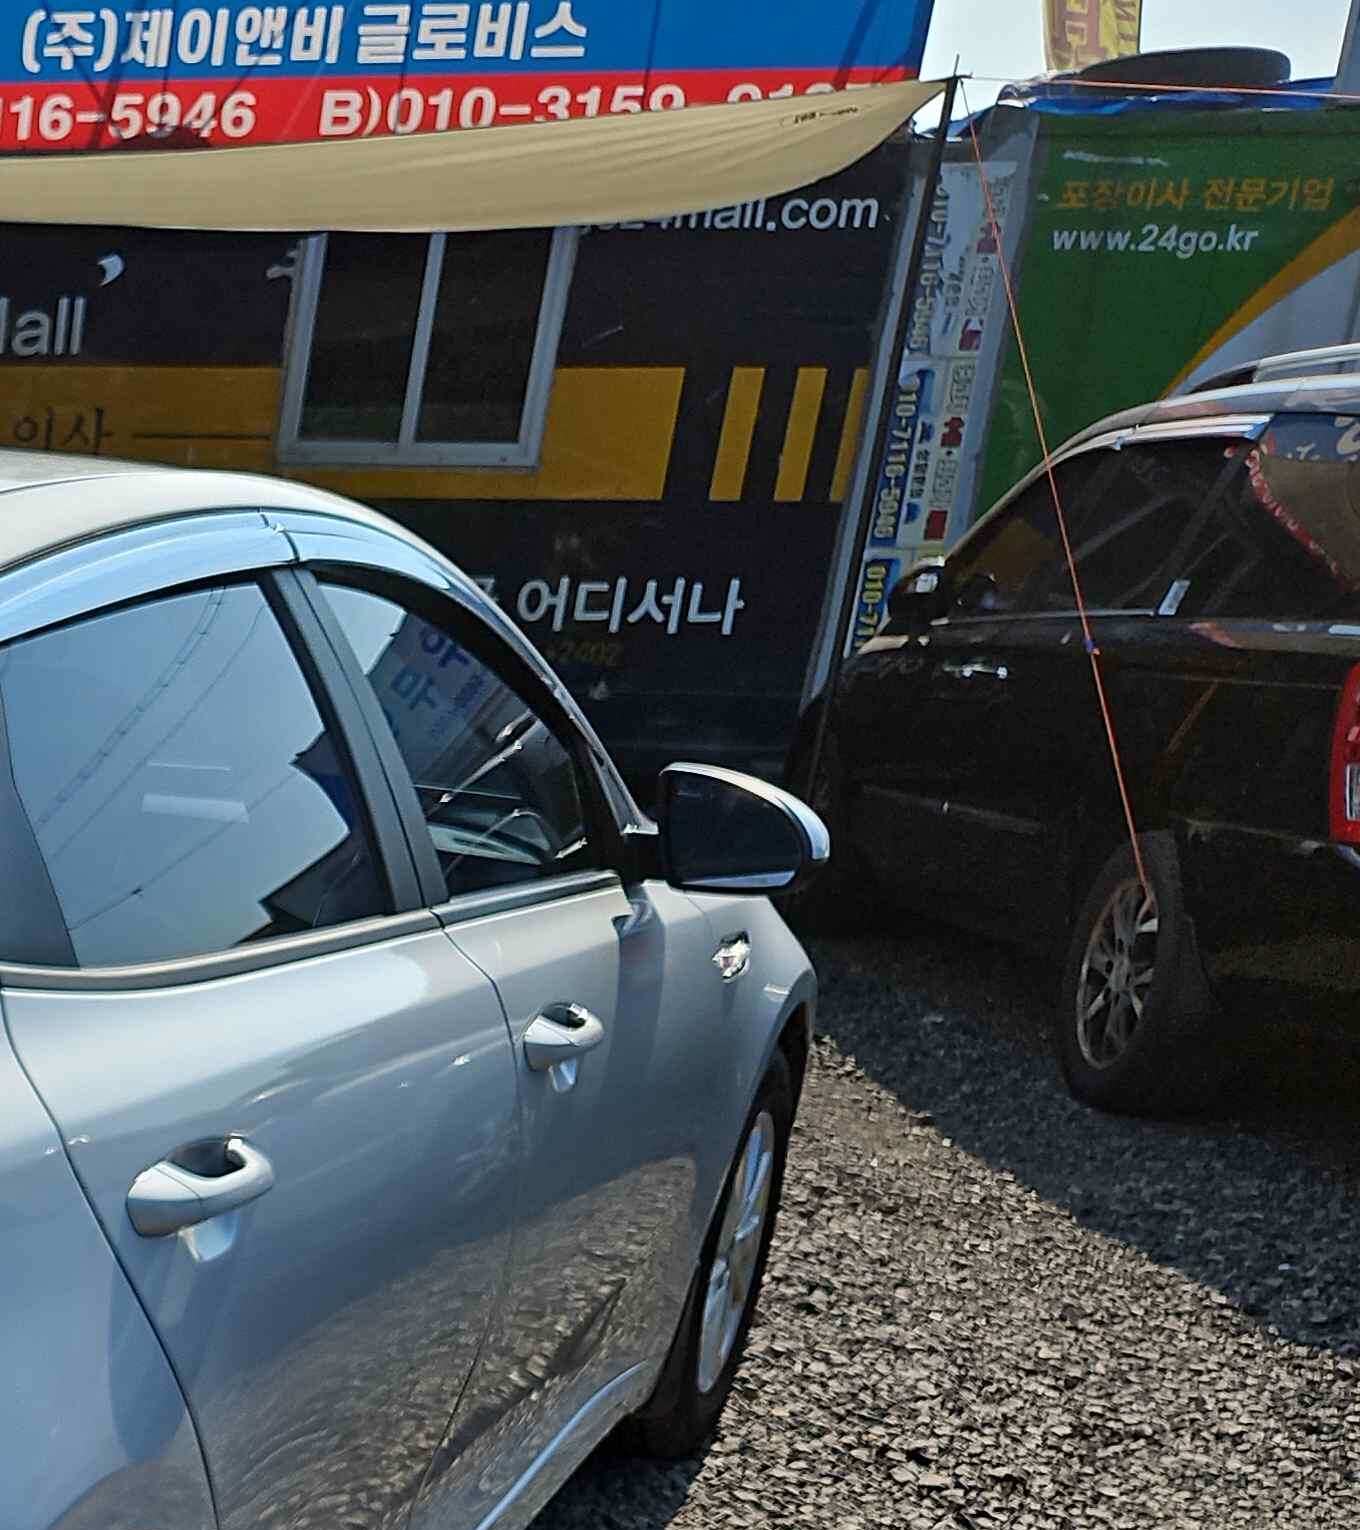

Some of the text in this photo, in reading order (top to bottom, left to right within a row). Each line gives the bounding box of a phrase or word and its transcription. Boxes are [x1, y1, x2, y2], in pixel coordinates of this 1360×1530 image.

[22, 2, 588, 73] (주)제이앤비 글로비스
[1056, 176, 1190, 212] 포장이사
[1202, 175, 1334, 212] 전문기업
[1052, 223, 1259, 259] www.24go.kr
[12, 405, 113, 454] 이사
[517, 575, 746, 635] 어디서나
